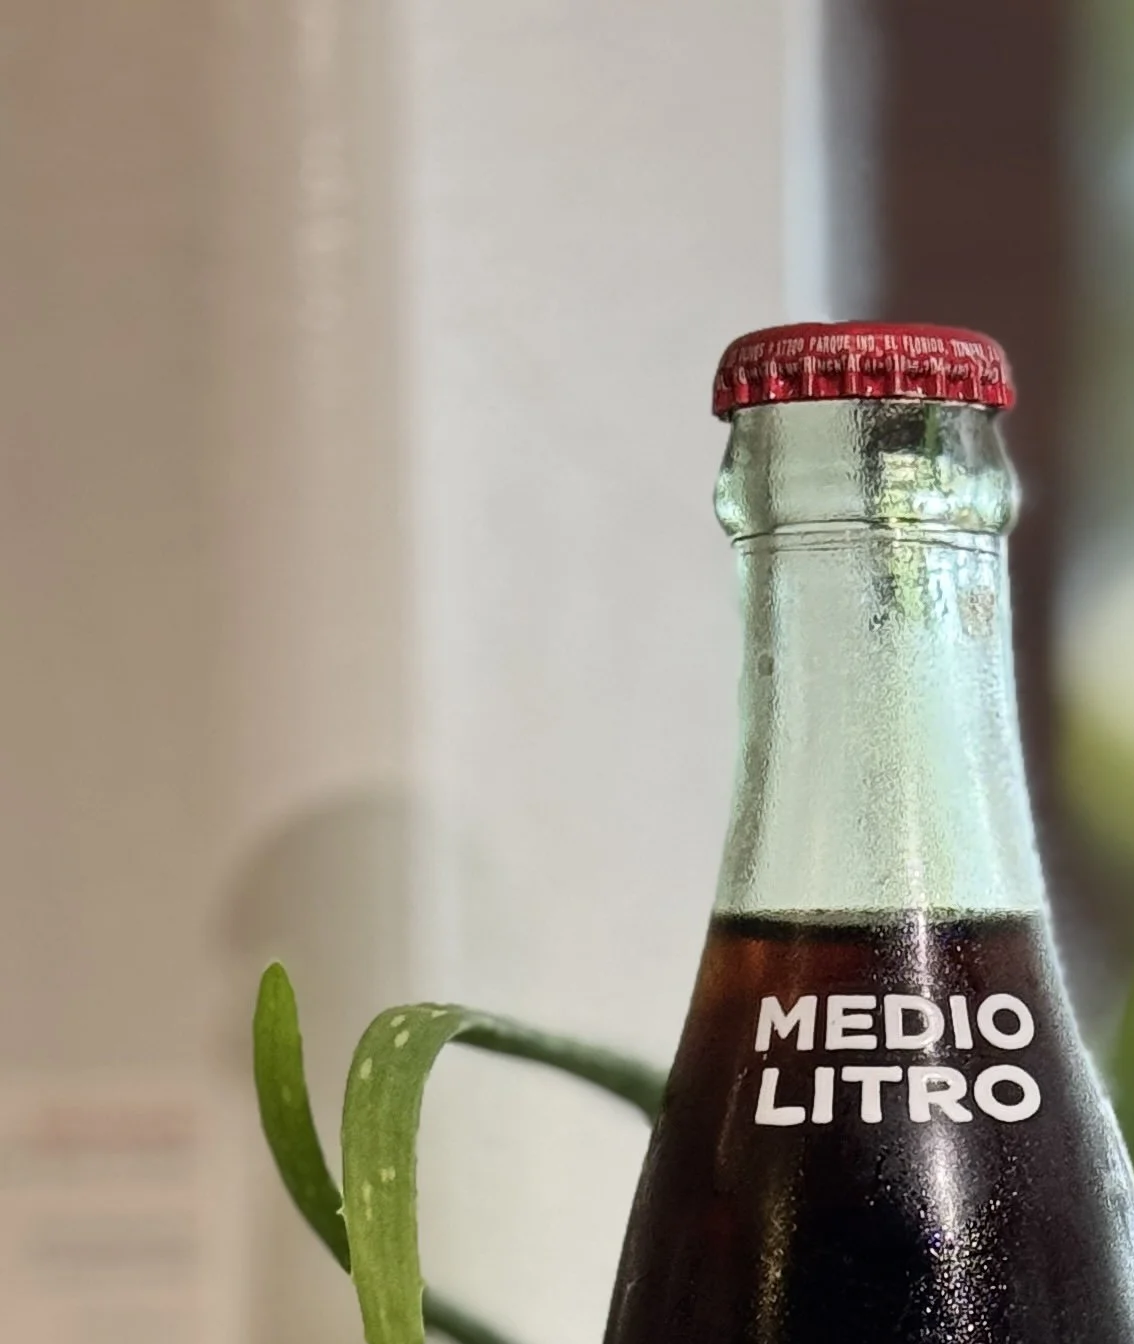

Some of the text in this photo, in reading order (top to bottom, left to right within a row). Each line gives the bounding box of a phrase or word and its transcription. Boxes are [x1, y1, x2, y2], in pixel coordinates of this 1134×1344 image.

[809, 334, 850, 354] PARQUE
[884, 334, 898, 351] EL
[755, 993, 1034, 1051] MEDIO
[755, 1064, 1041, 1126] LITRO
